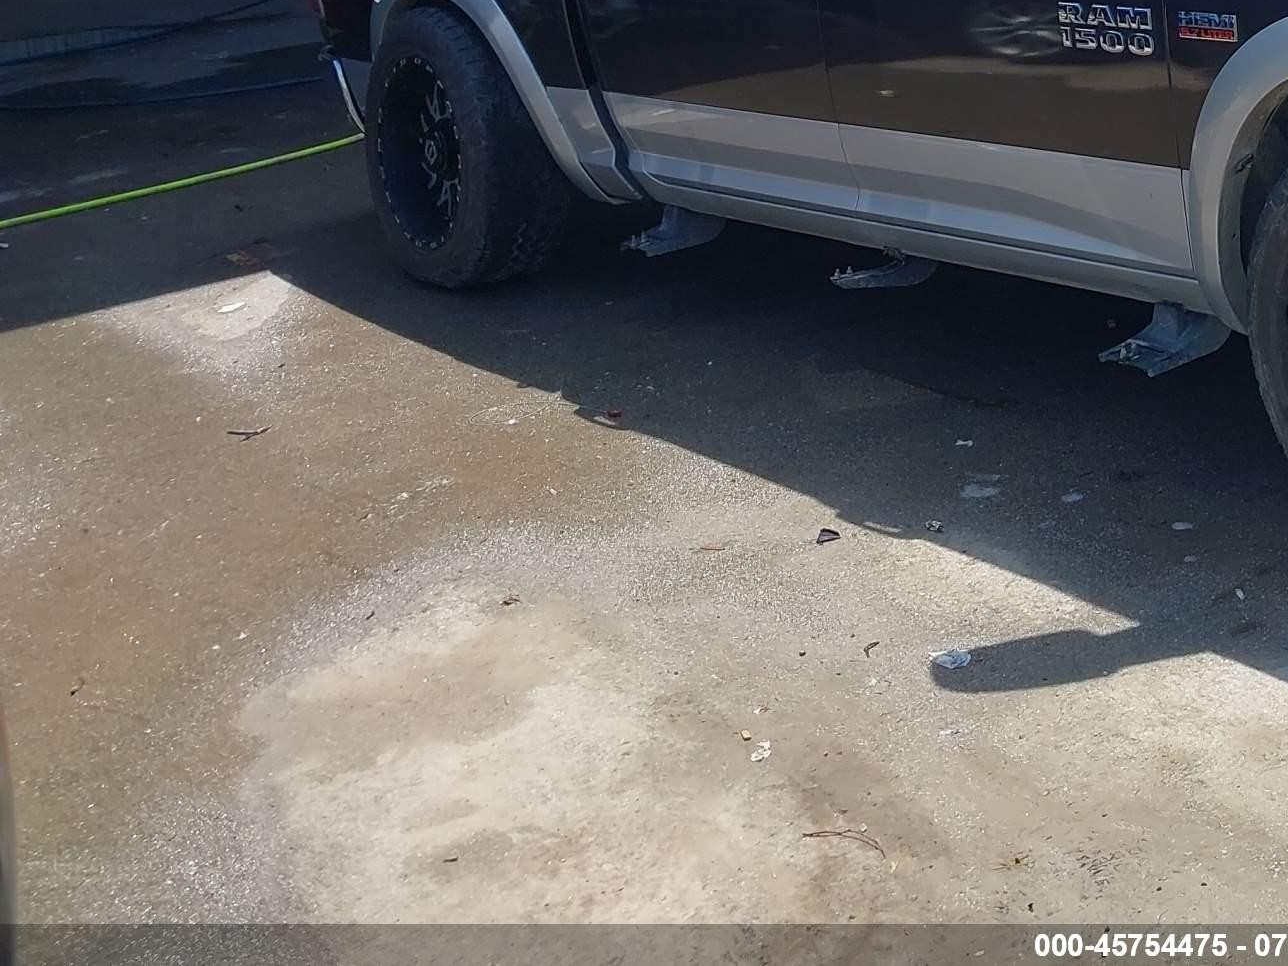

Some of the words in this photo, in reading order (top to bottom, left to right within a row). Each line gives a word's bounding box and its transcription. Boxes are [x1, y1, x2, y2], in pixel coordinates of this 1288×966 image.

[1058, 1, 1153, 30] RAM
[1178, 10, 1237, 29] HEMI
[1060, 26, 1155, 56] 1500
